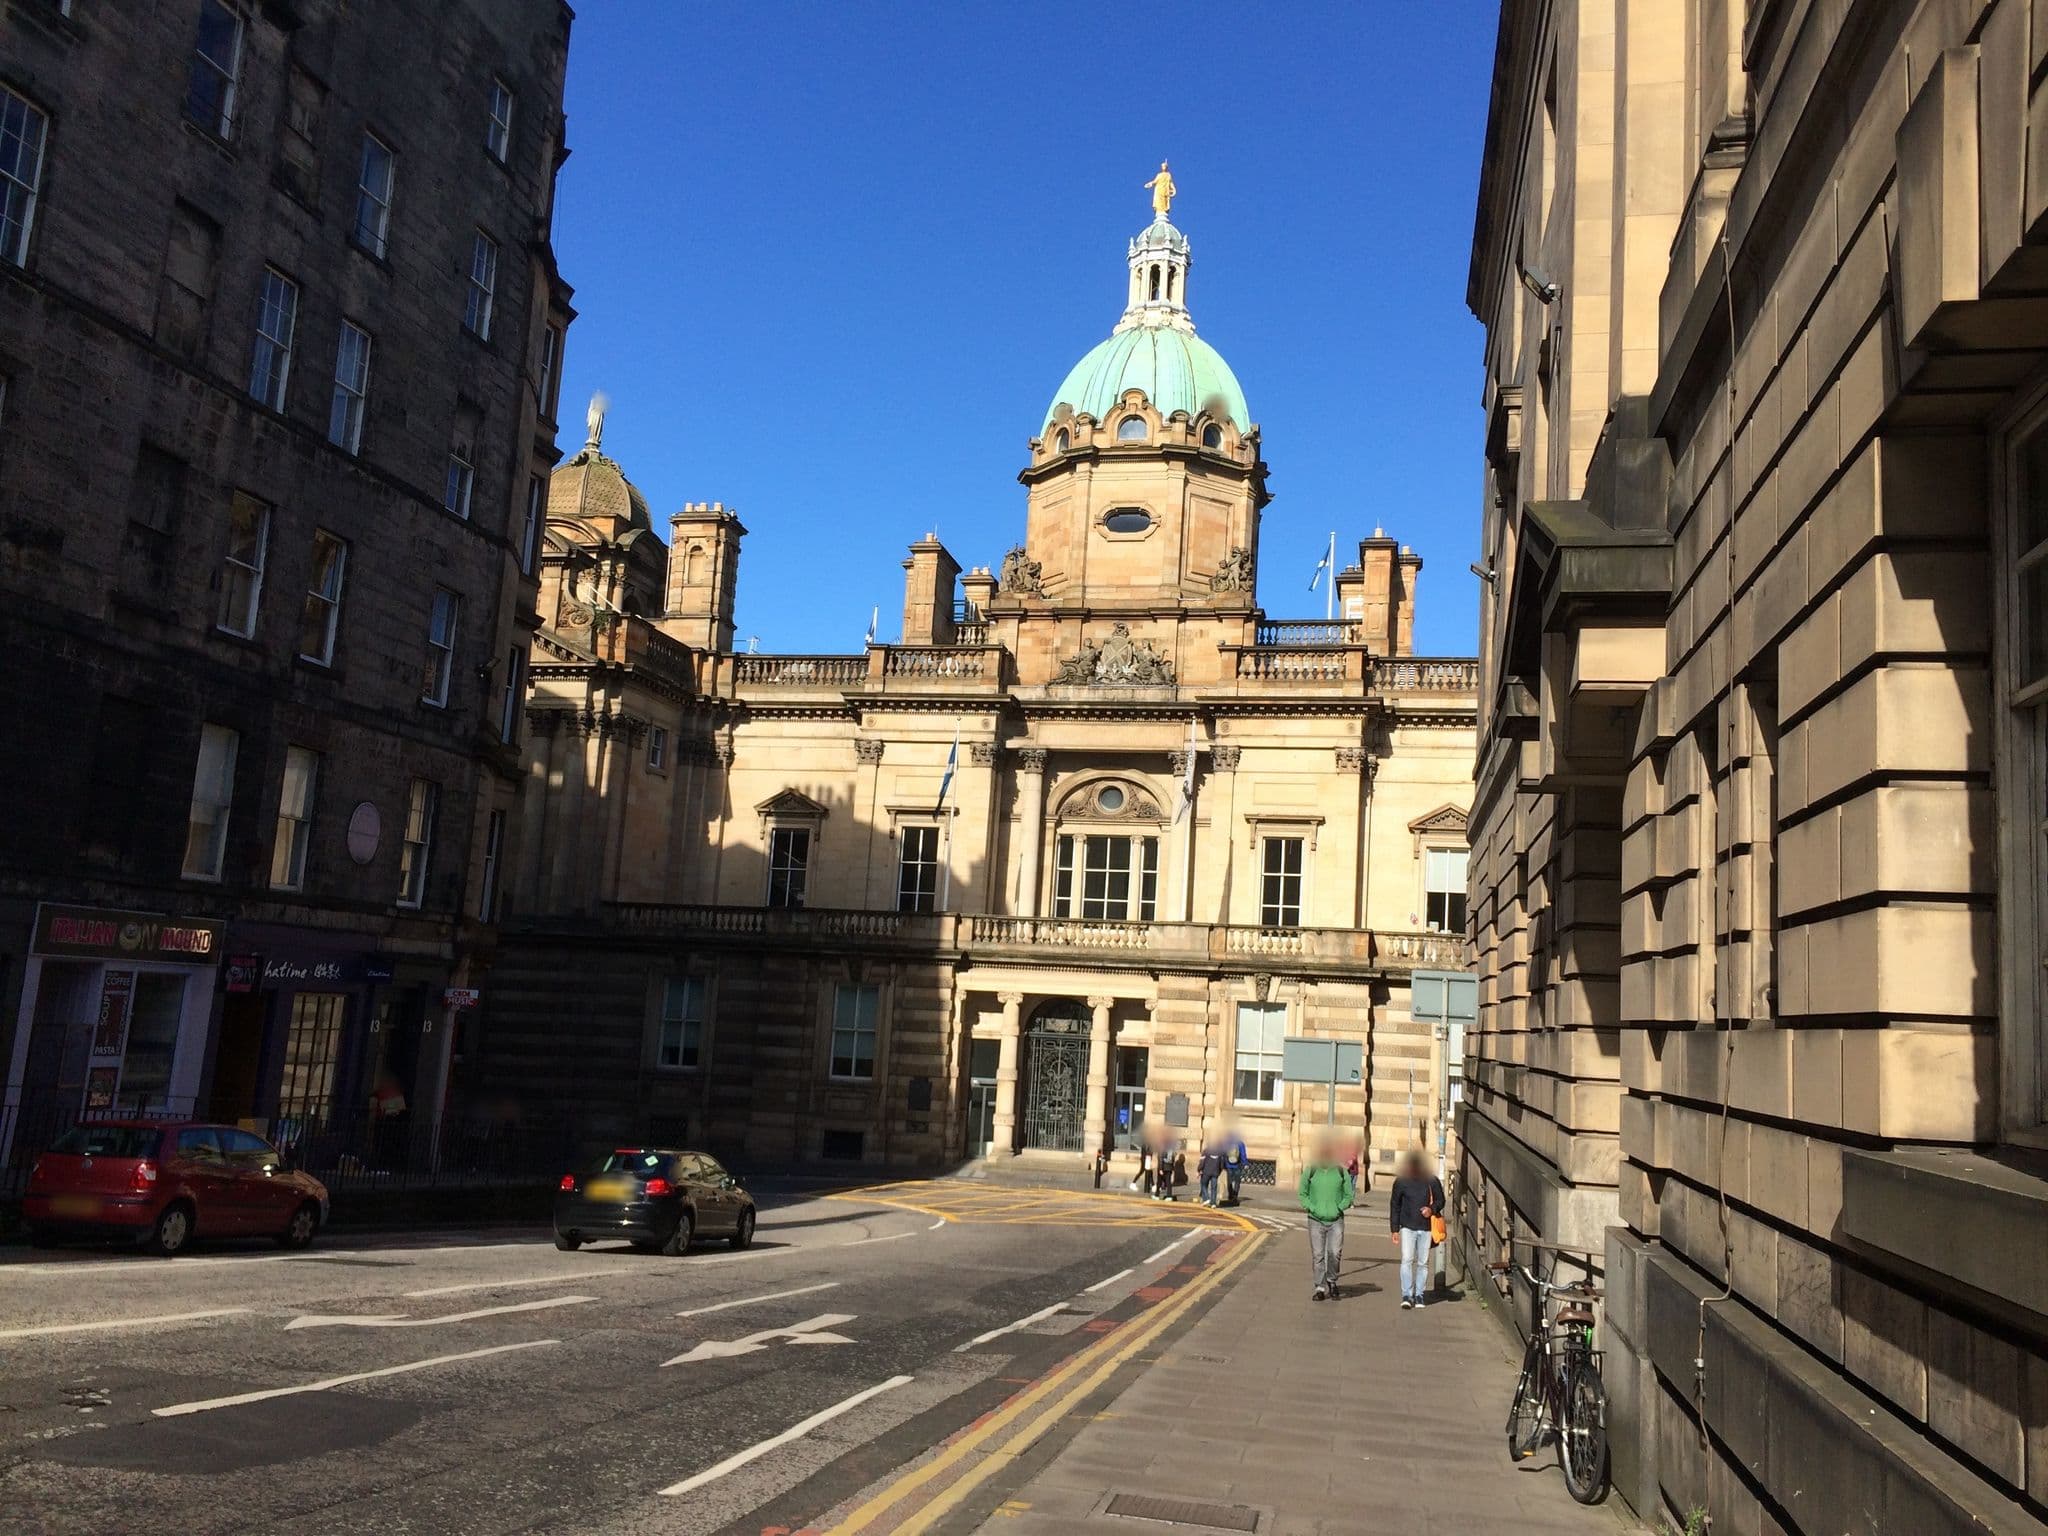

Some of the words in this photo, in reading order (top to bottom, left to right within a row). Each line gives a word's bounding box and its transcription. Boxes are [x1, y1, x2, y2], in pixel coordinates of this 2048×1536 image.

[52, 917, 118, 945] ITALIAN
[159, 927, 212, 953] MOUND
[264, 959, 307, 978] hatime
[105, 976, 132, 986] COFFEE
[447, 996, 474, 1006] MUSIC
[100, 995, 111, 1026] SOUP
[369, 1019, 380, 1033] 13
[423, 1019, 432, 1033] 13
[95, 1046, 115, 1055] PASTA
